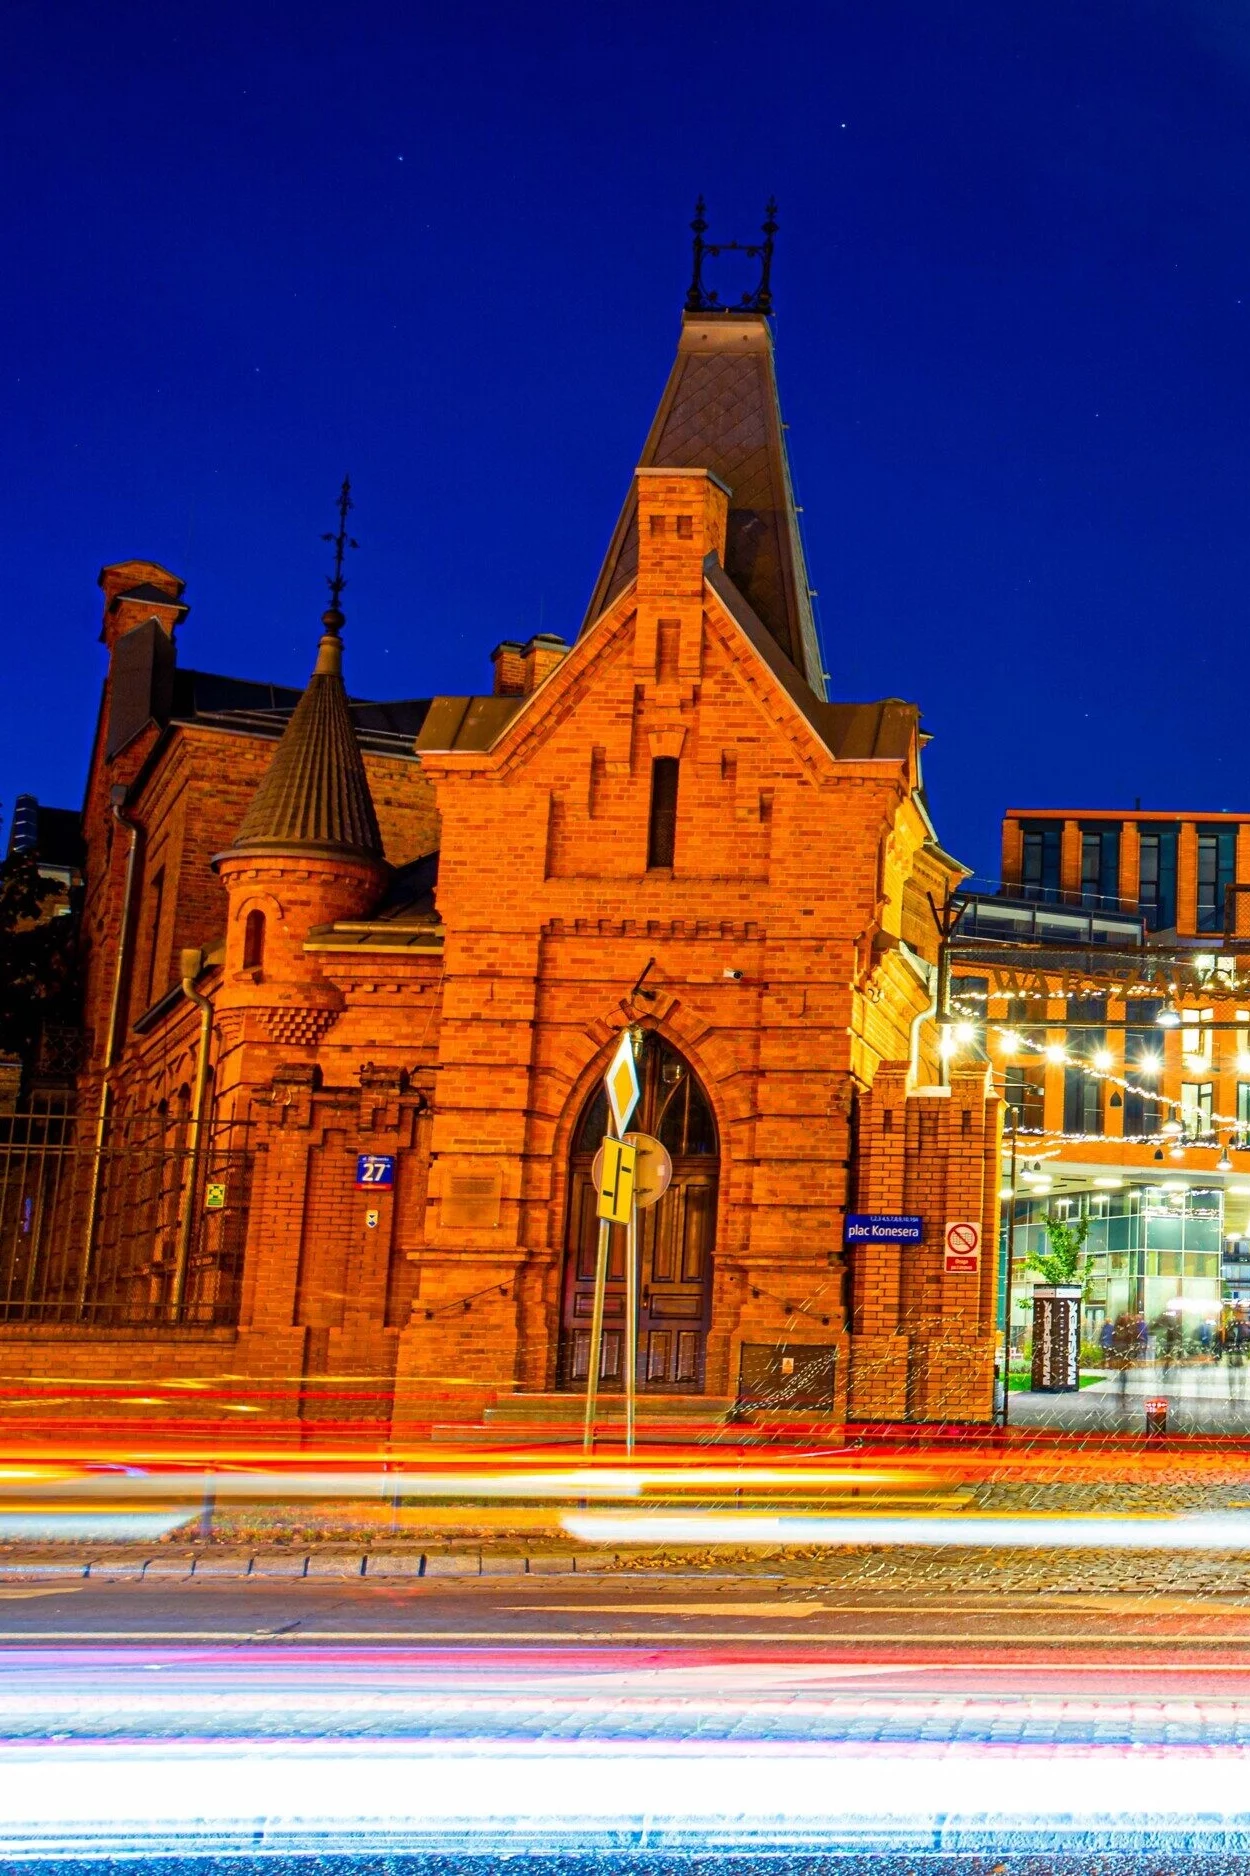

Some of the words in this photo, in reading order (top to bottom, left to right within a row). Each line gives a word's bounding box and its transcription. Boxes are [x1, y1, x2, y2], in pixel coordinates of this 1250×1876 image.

[362, 1163, 386, 1181] 27
[848, 1224, 870, 1238] plac
[872, 1225, 919, 1237] Konesera
